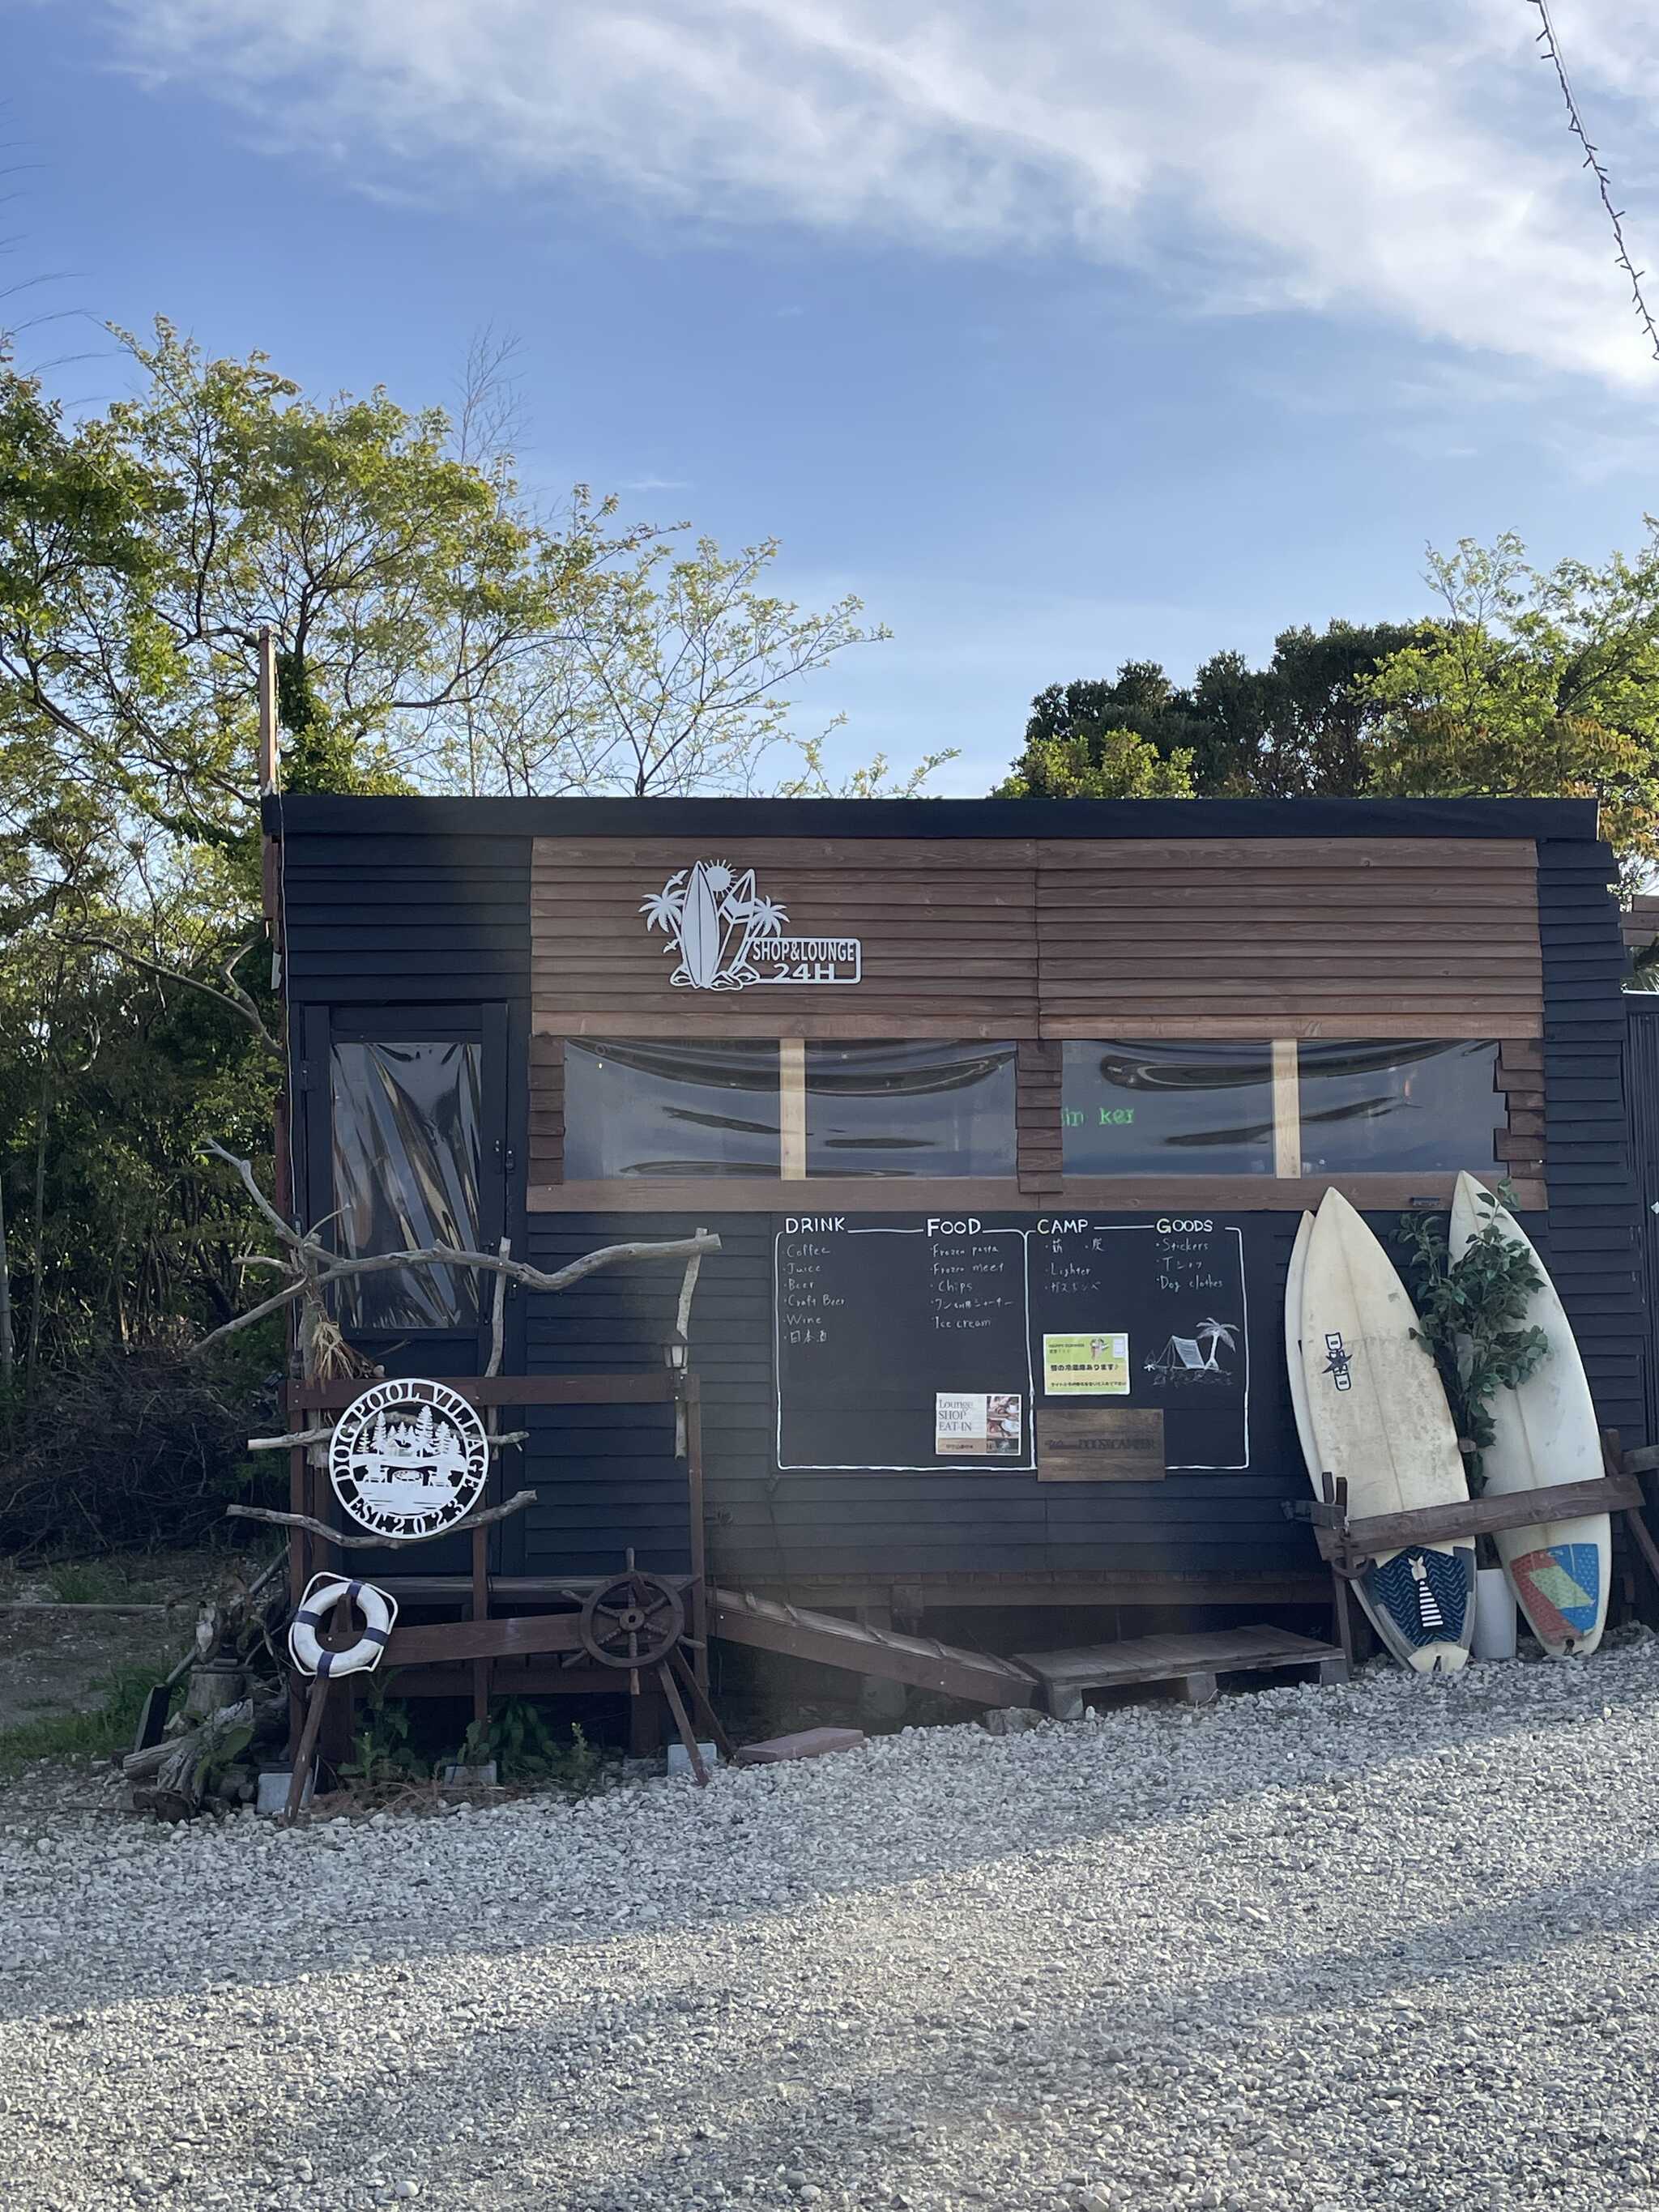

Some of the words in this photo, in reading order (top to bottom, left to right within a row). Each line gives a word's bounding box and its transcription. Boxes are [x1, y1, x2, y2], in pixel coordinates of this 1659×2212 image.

[753, 941, 855, 961] SHOP&LOUNGE
[773, 963, 834, 981] 24H
[785, 1217, 846, 1234] DRINK
[927, 1217, 982, 1237] FOOD
[1037, 1218, 1089, 1235] CAMP
[1156, 1217, 1213, 1234] GOODS
[787, 1243, 830, 1257] Coffee
[1162, 1237, 1209, 1252] Stickers
[787, 1262, 823, 1275] Juice
[1050, 1262, 1091, 1277] Lighter
[788, 1277, 816, 1291] Beer
[938, 1279, 974, 1294] Chips
[1159, 1275, 1180, 1293] Dog
[1188, 1273, 1223, 1290] clothes
[787, 1294, 817, 1307] Craft
[822, 1294, 845, 1306] Beer
[787, 1313, 823, 1326] Wine
[934, 1315, 952, 1329] Ice
[956, 1318, 992, 1329] cream
[938, 1410, 966, 1420] SHOP
[334, 1426, 356, 1482] DOG
[352, 1382, 420, 1421] POOL
[433, 1384, 486, 1491] VILLAGE
